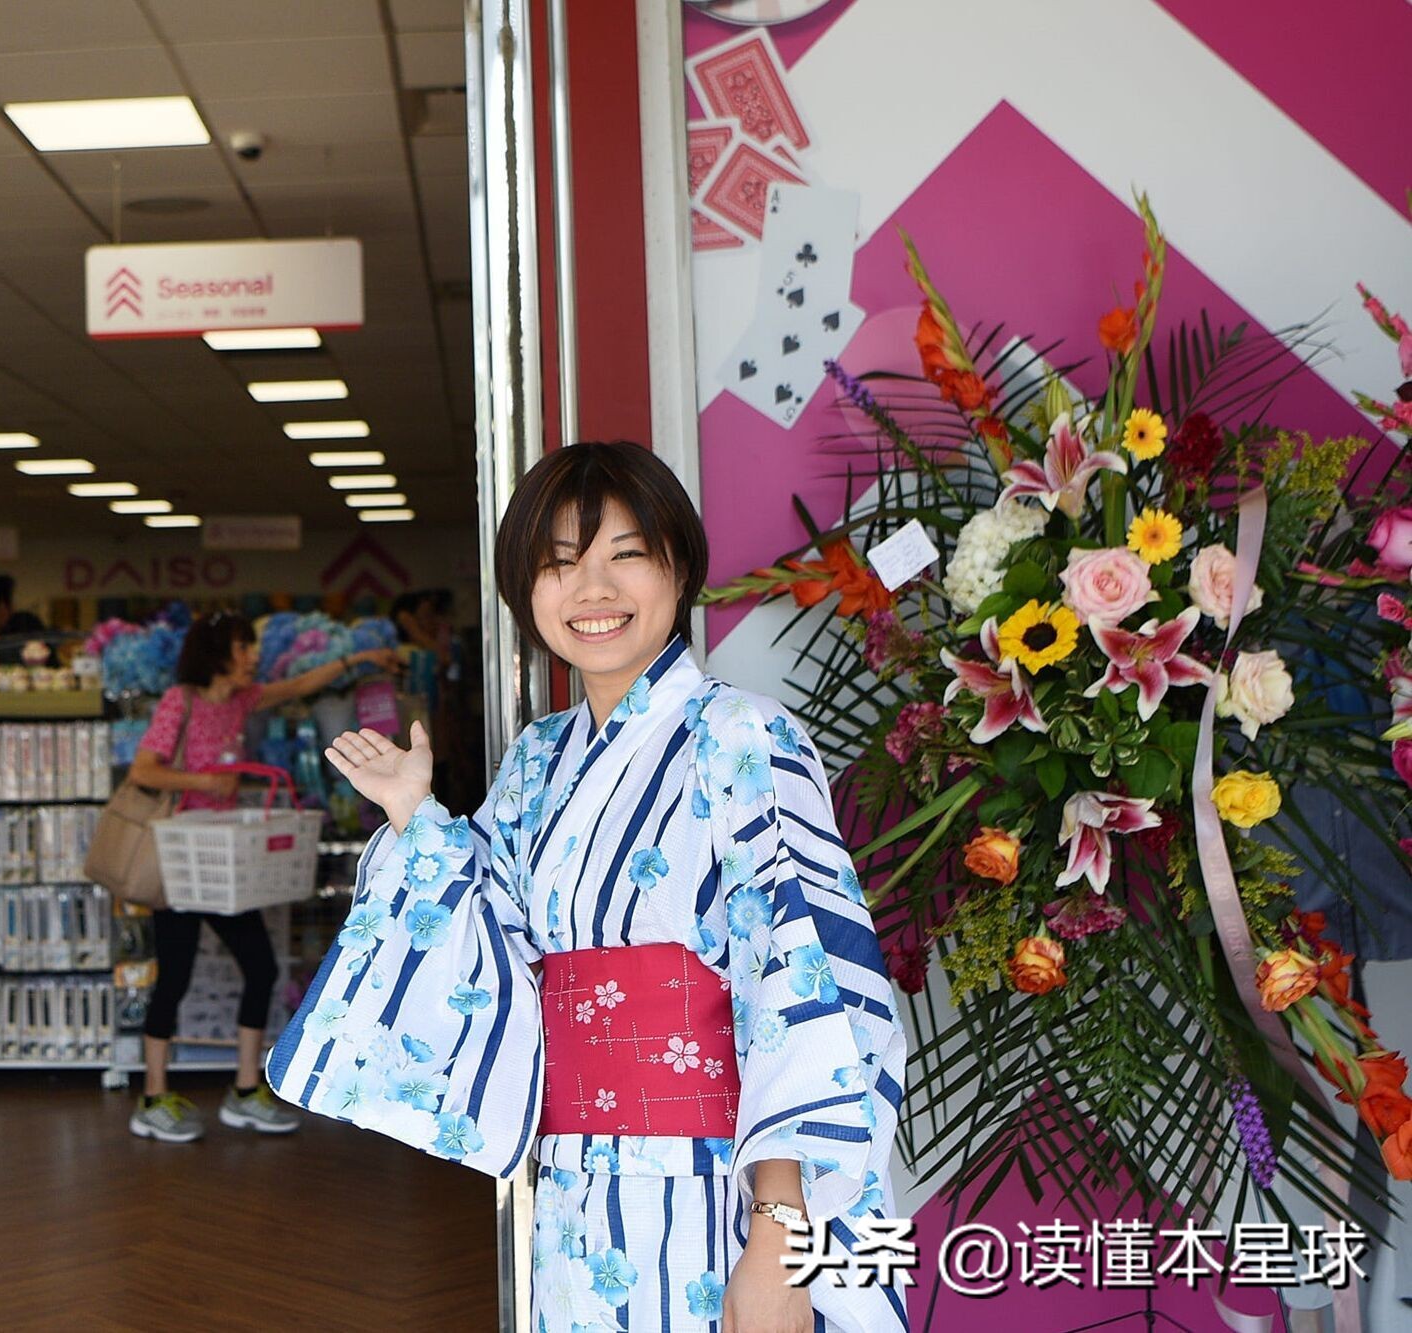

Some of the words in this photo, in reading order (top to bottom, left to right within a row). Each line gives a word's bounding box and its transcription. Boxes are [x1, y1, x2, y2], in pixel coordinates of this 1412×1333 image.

[771, 188, 780, 203] A
[157, 272, 273, 299] Seasonal
[783, 270, 796, 286] 5
[65, 552, 237, 592] DAISO
